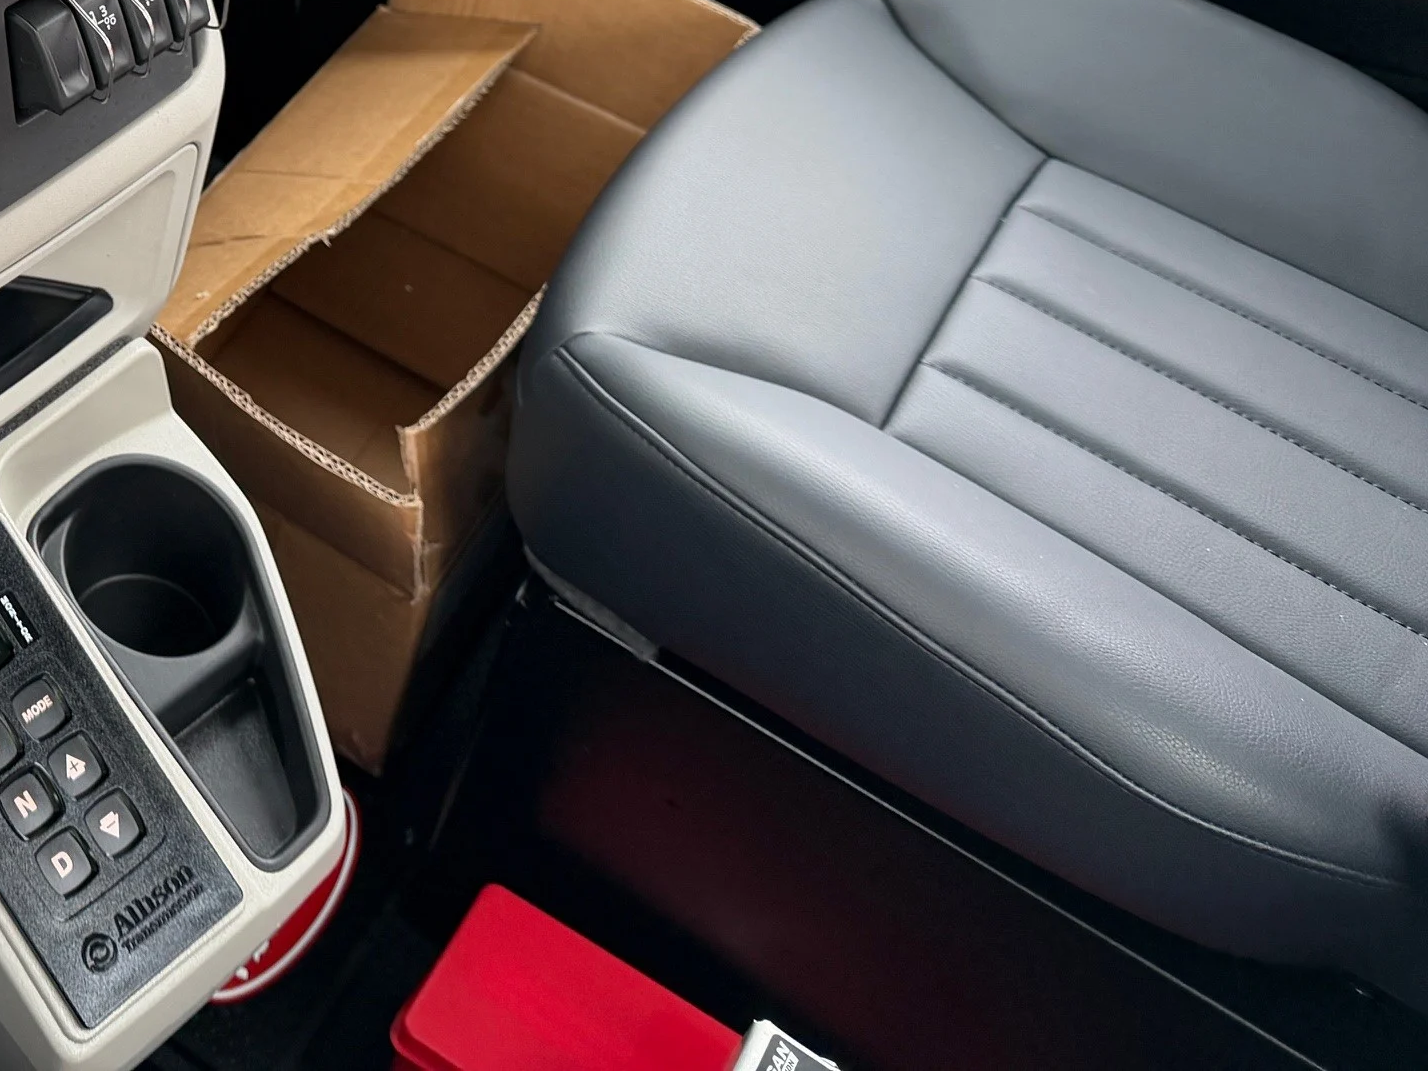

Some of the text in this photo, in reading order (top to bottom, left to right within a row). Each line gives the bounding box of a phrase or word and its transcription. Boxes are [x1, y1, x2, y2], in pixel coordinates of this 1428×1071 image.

[21, 694, 53, 724] MODE
[13, 789, 38, 819] N
[50, 851, 73, 879] D
